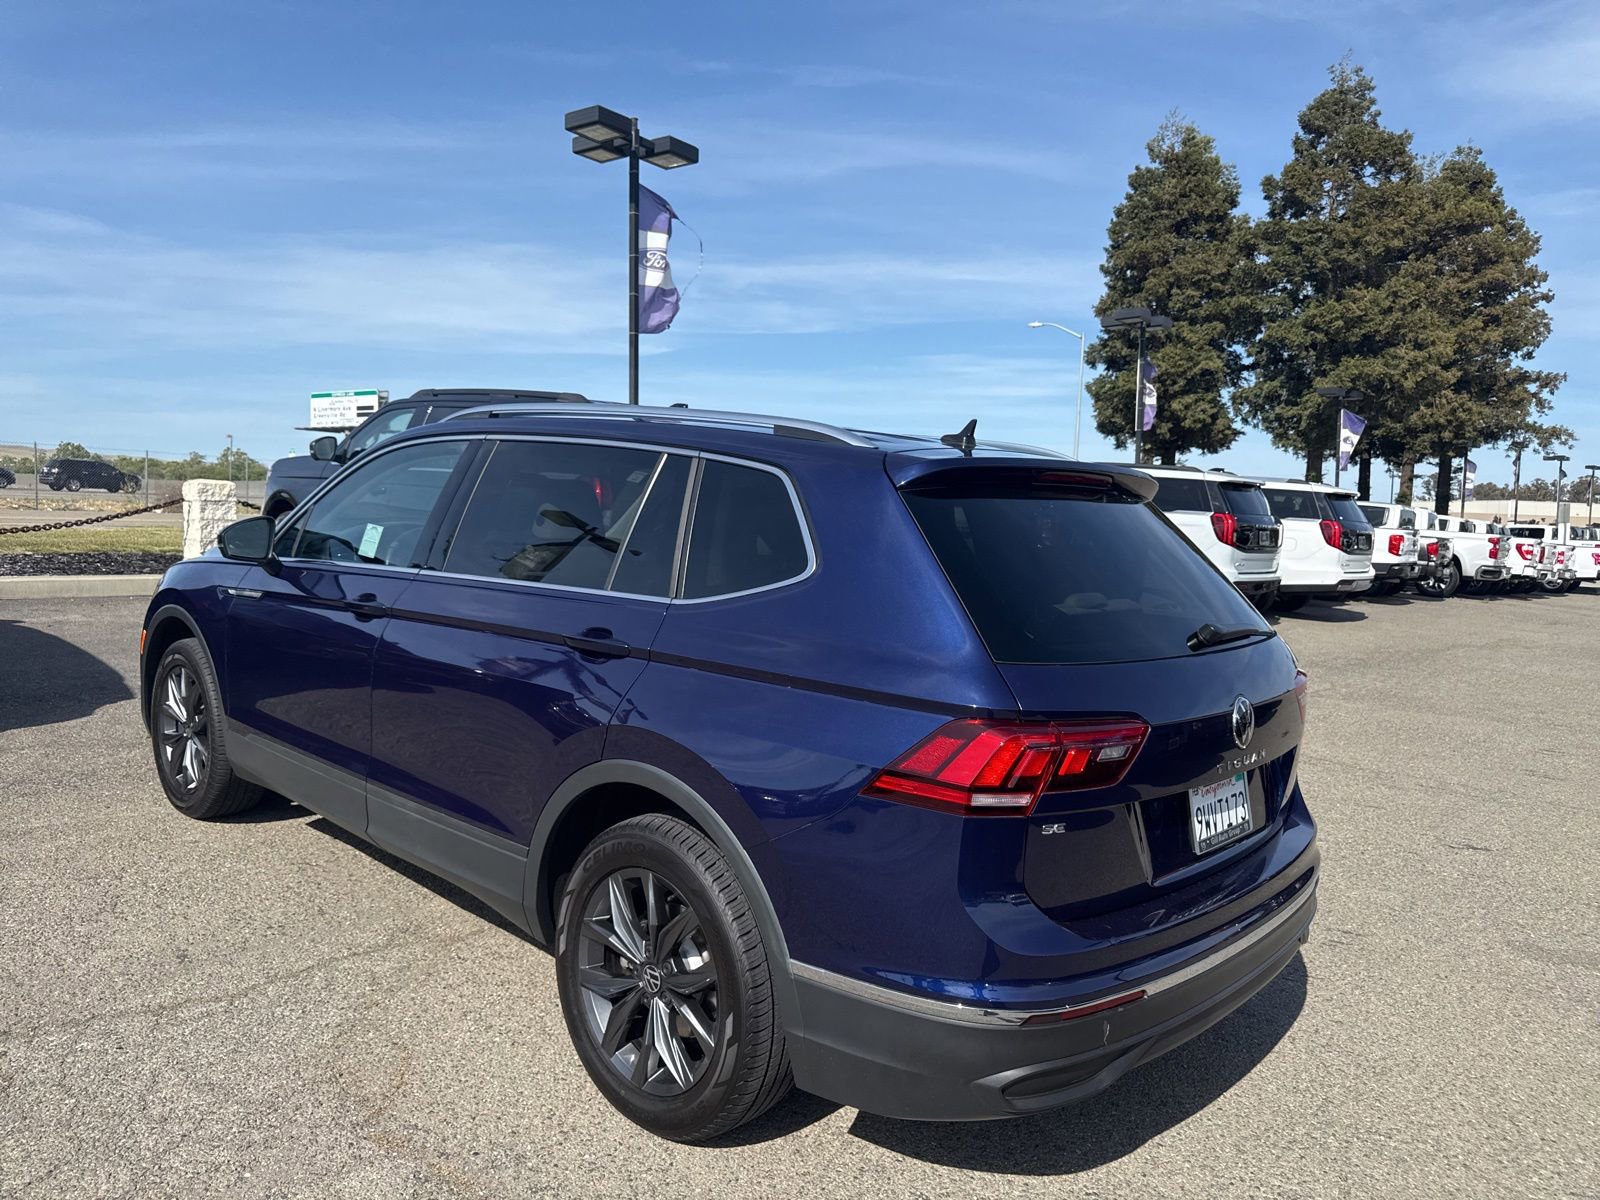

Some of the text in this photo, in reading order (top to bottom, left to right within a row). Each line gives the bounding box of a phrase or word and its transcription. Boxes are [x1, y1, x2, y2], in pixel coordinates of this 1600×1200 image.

[643, 250, 667, 268] For
[1216, 748, 1267, 774] TIGUAN
[1195, 790, 1248, 841] 9WVT173
[1041, 822, 1067, 835] SE
